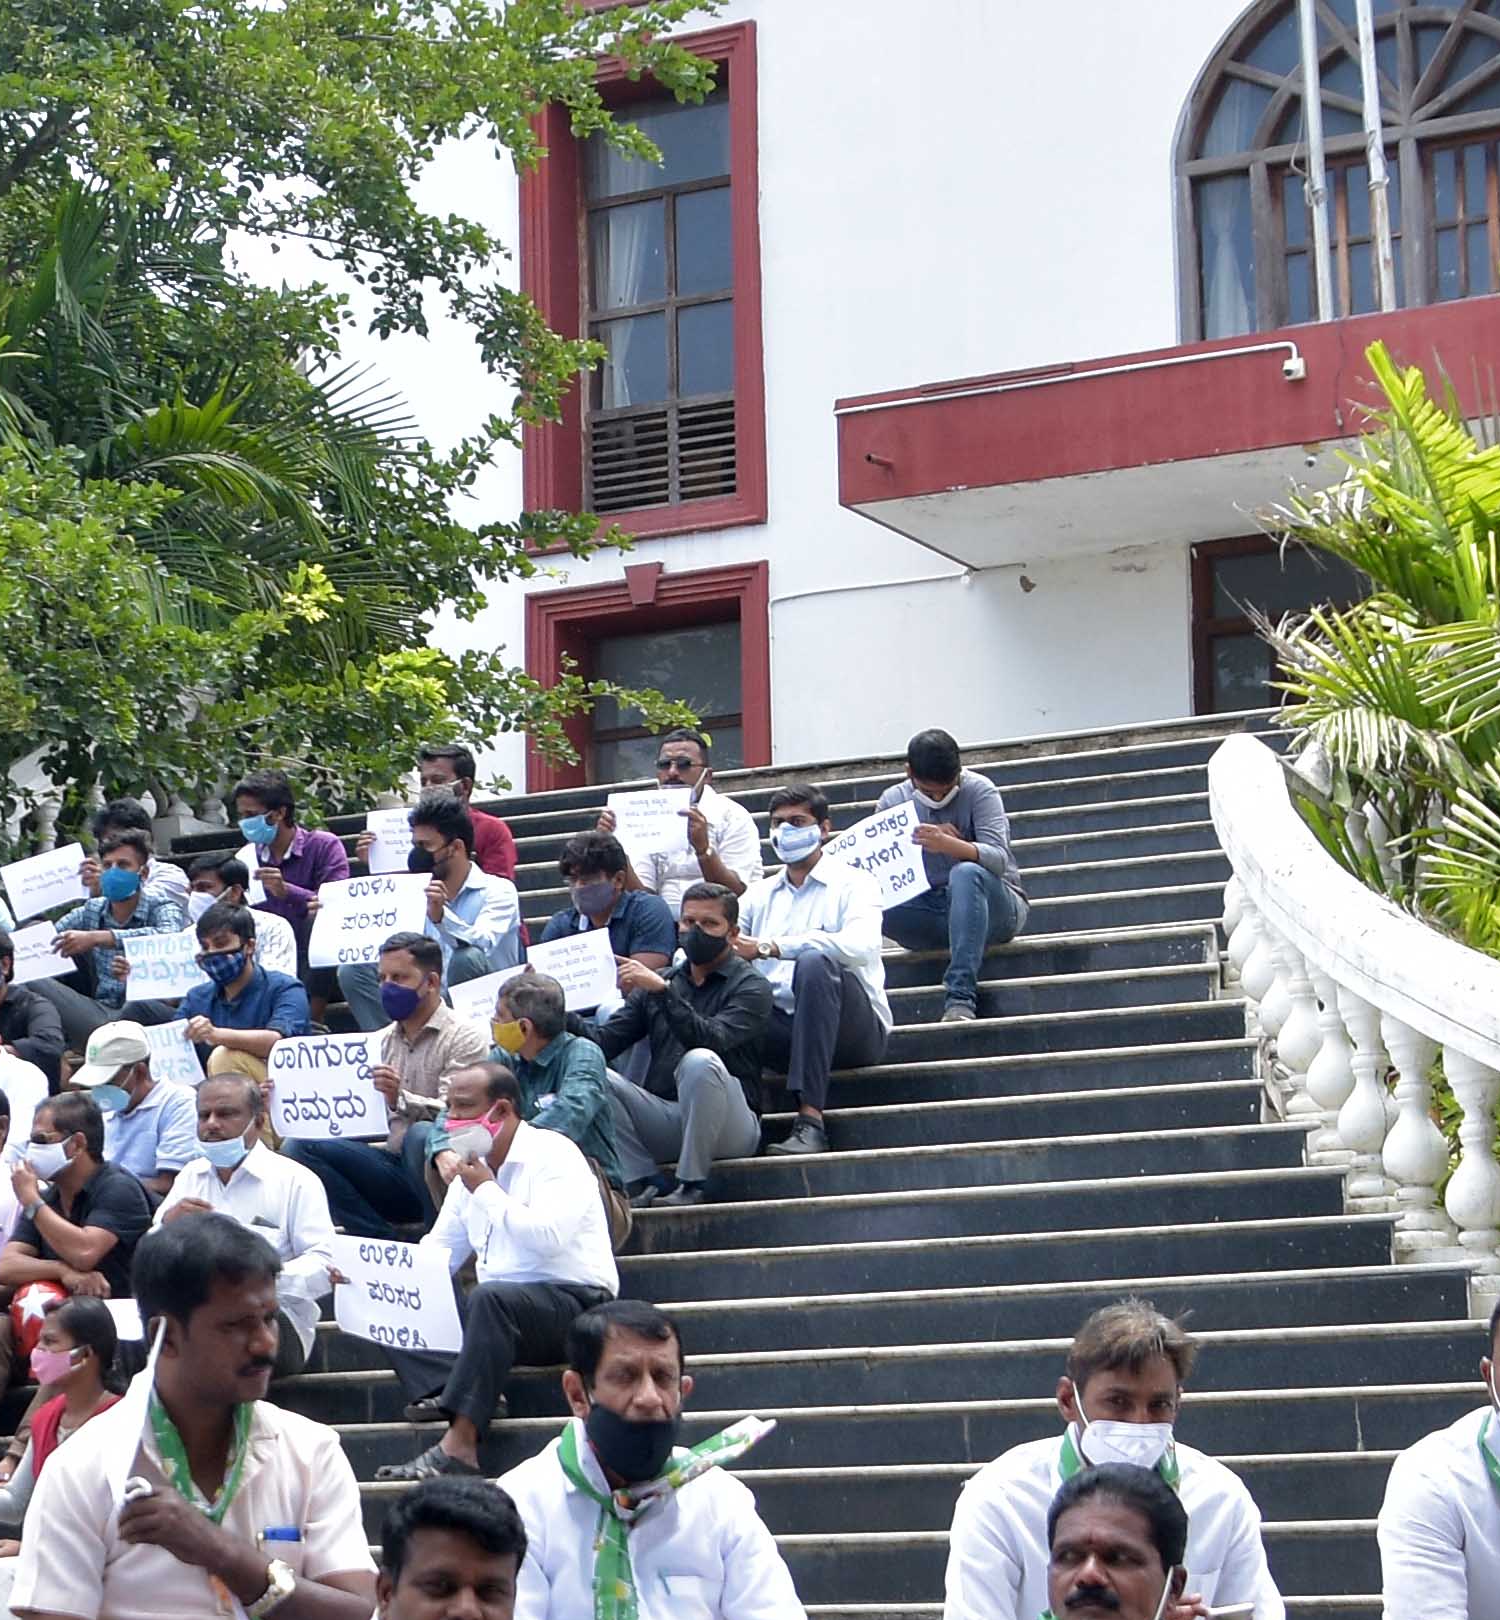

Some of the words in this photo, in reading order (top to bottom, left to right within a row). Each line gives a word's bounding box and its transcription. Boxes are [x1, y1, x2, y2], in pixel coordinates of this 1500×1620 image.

[274, 1037, 374, 1080] ರಾಗಿಗುಡ್ಡ
[282, 1089, 366, 1136] ನಮ್ಮದು
[360, 1244, 413, 1268] ಉಳಿಸಿ
[366, 1280, 421, 1310] ಪರಿಸರ
